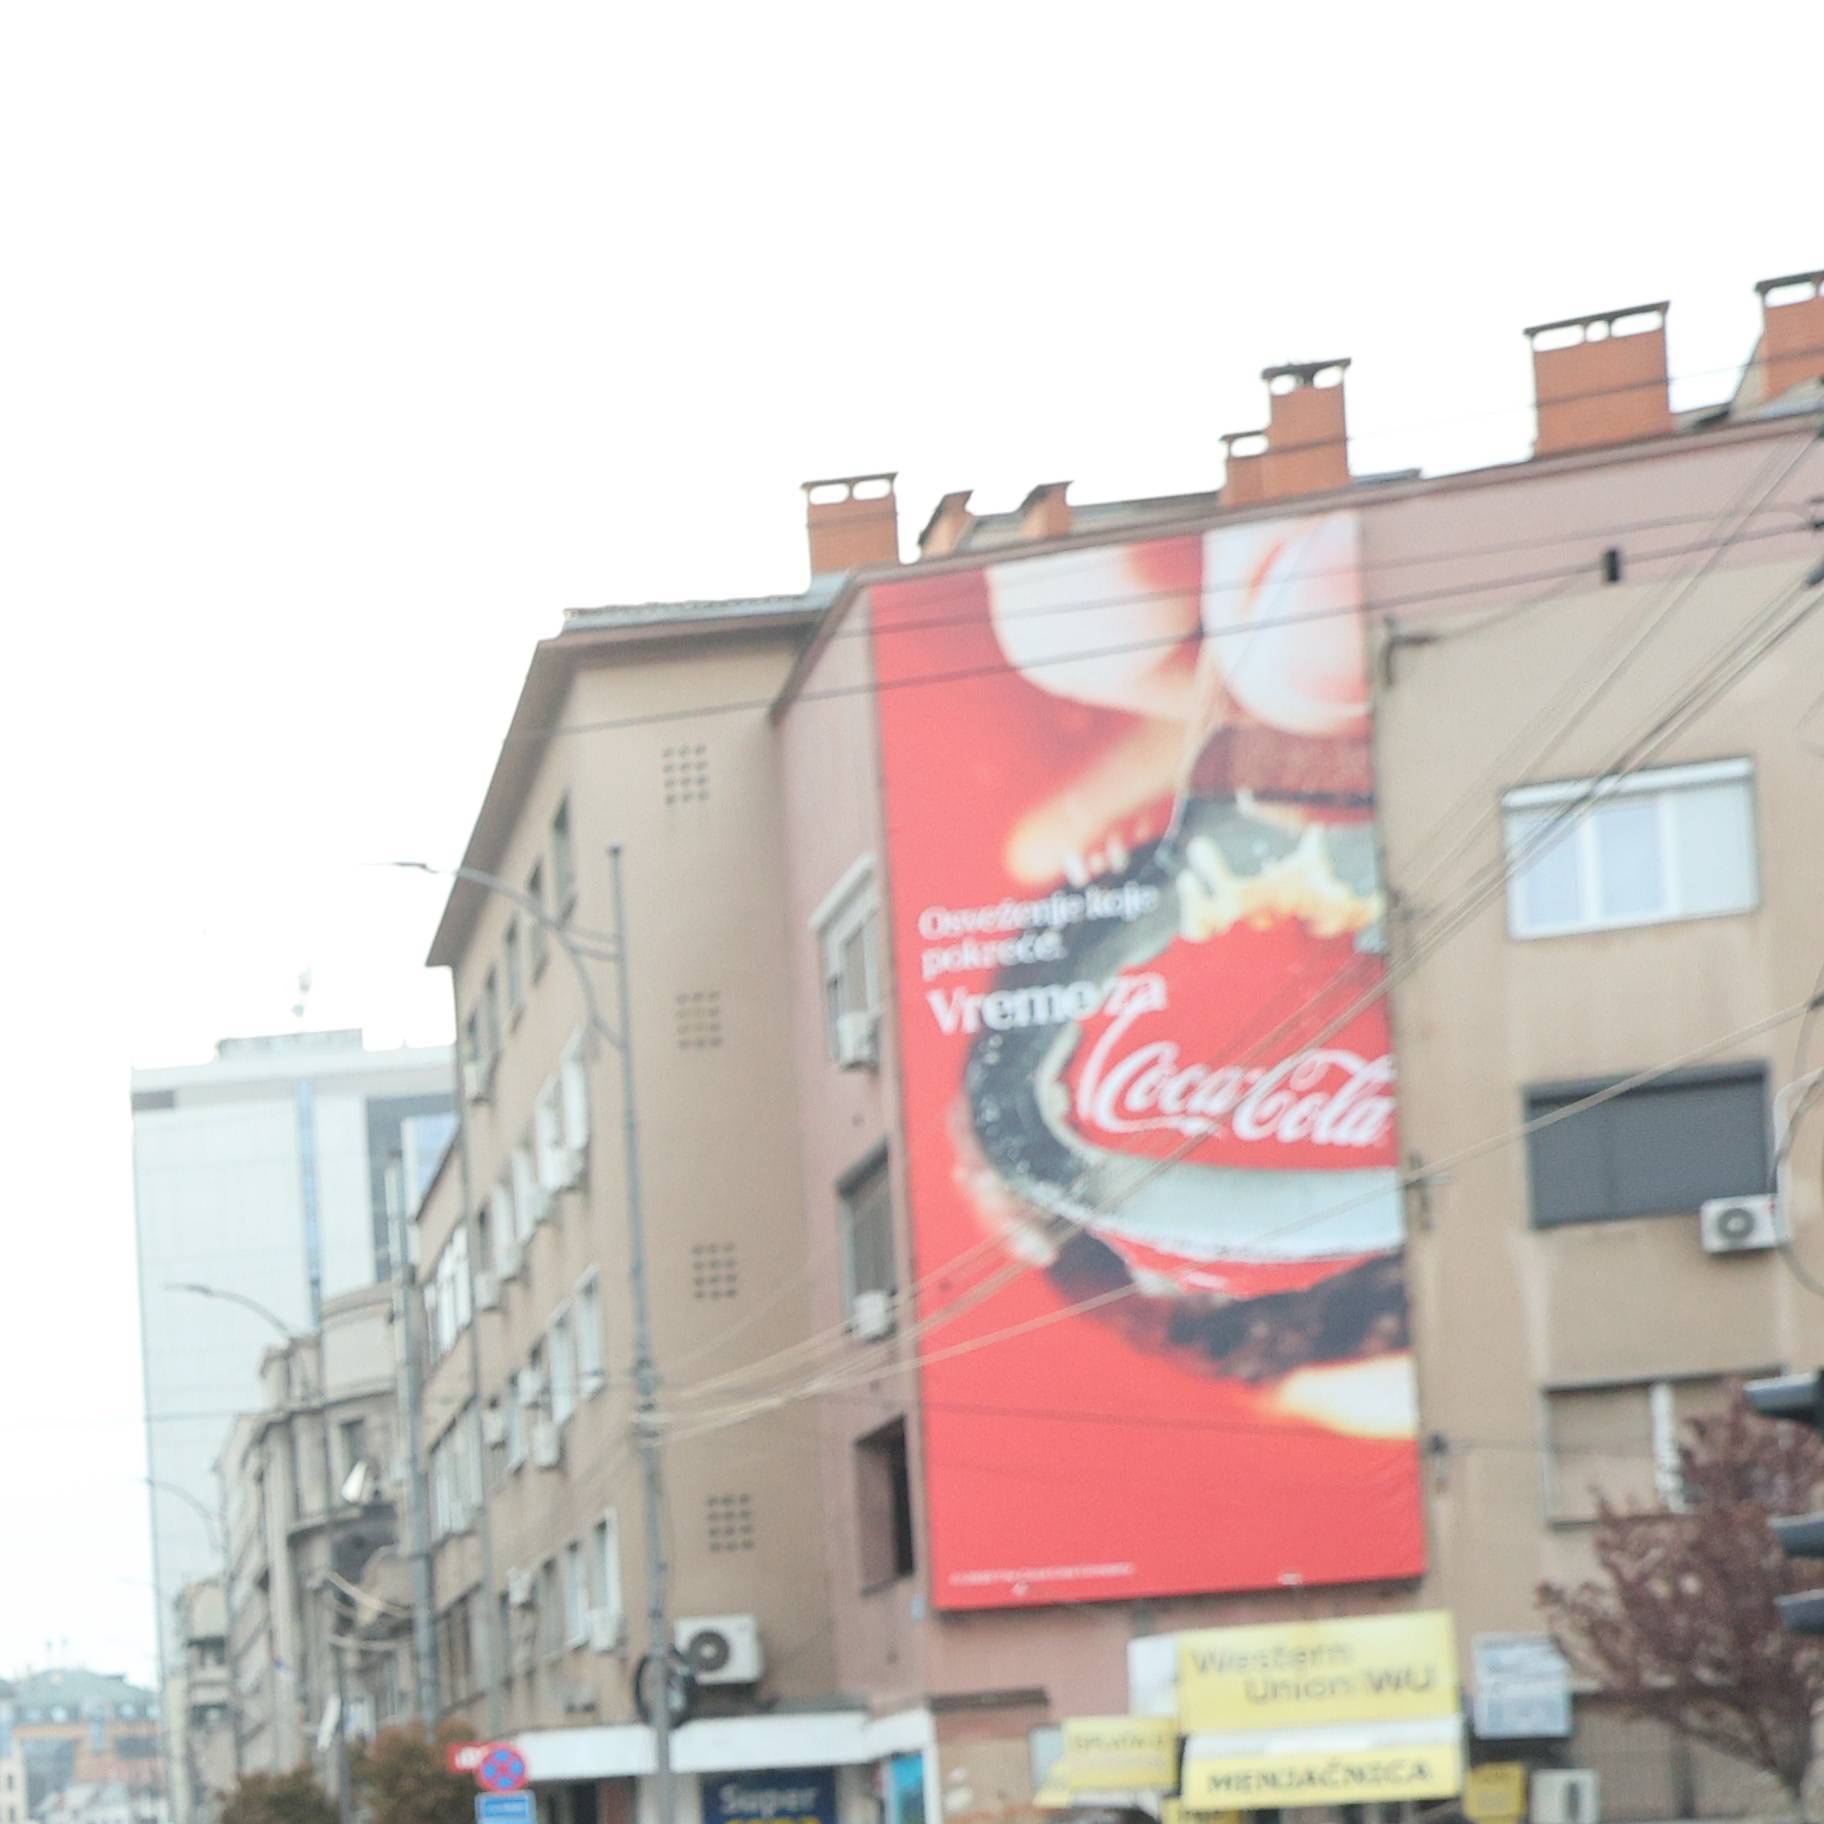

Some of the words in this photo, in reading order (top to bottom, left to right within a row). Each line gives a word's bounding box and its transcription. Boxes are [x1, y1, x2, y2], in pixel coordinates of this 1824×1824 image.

[1102, 971, 1168, 1016] za
[1192, 1643, 1353, 1674] Western
[1244, 1674, 1352, 1705] Union
[719, 1783, 818, 1818] Super
